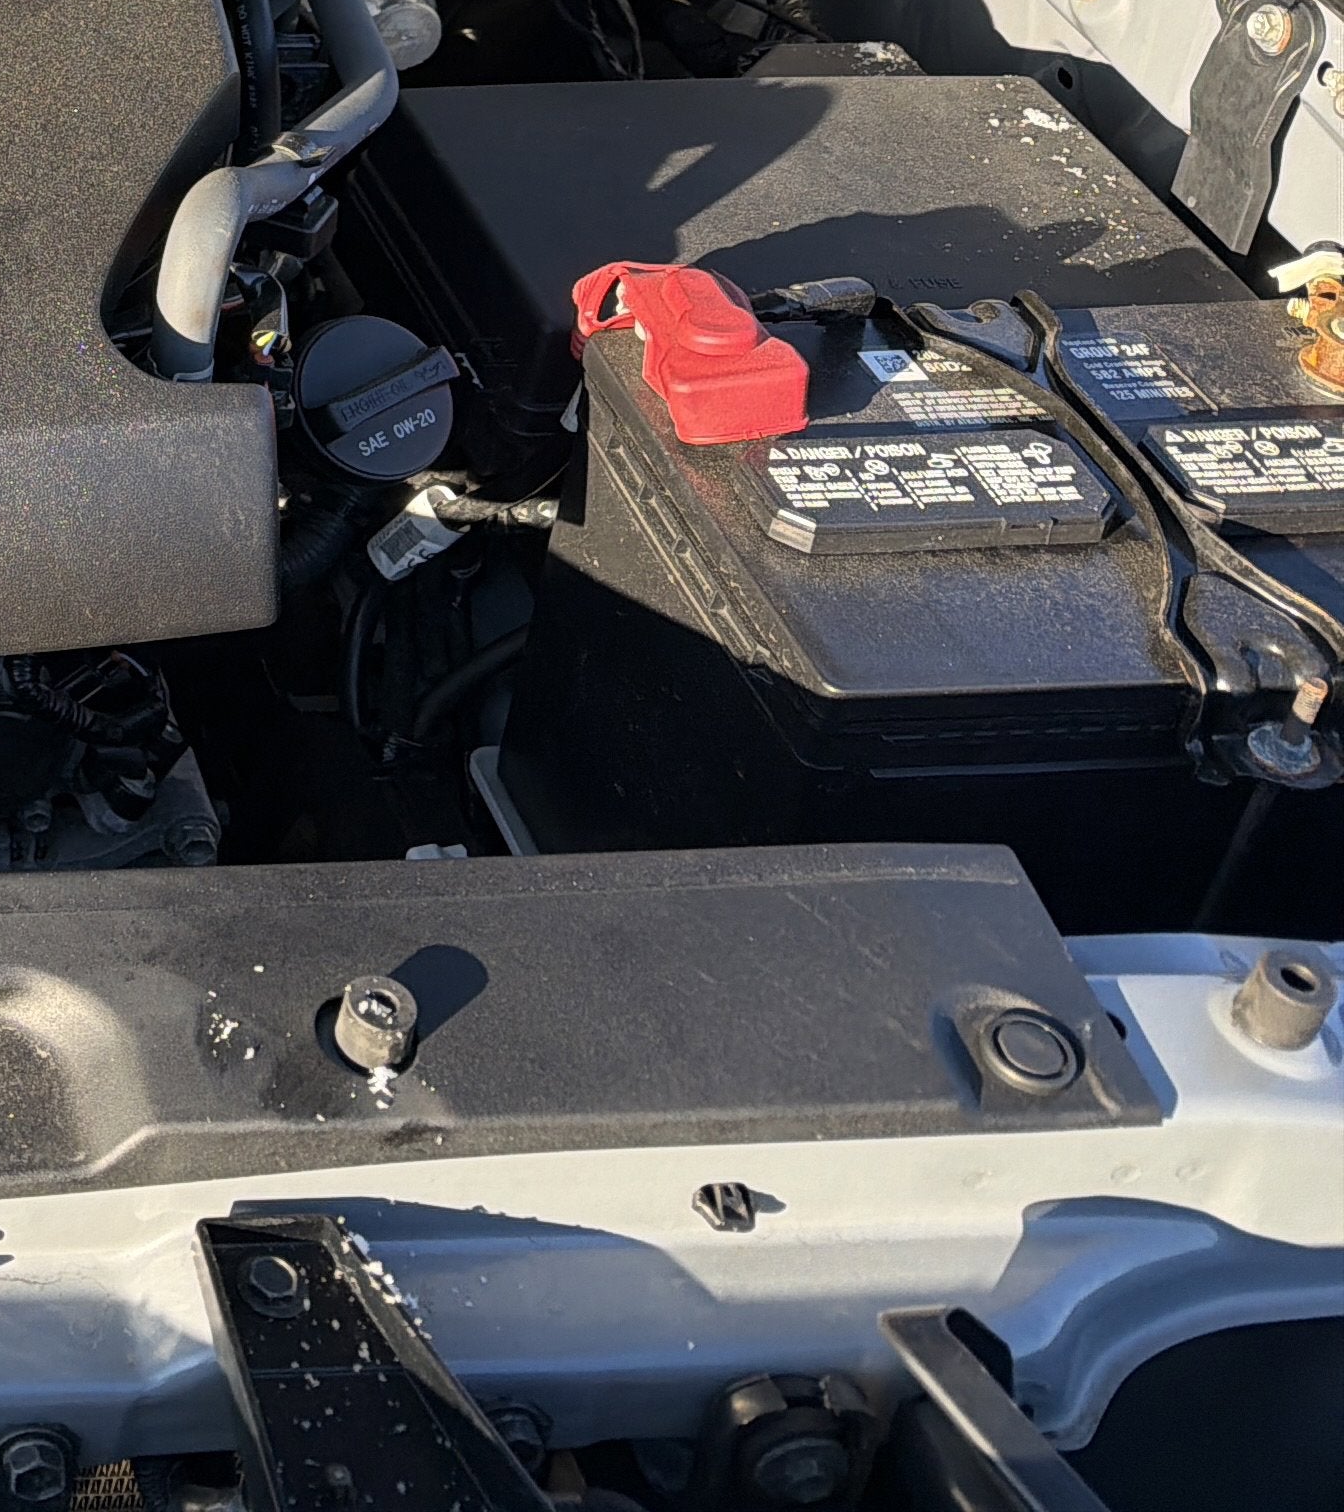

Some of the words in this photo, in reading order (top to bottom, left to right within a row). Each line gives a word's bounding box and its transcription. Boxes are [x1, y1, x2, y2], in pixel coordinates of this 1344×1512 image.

[909, 277, 964, 289] FUSE
[1069, 346, 1120, 359] GROUP
[1121, 343, 1152, 357] 24F
[1090, 369, 1122, 380] 582
[1123, 367, 1167, 379] AMPS
[1110, 389, 1135, 400] 125
[1136, 387, 1195, 399] MINUTES
[358, 431, 390, 457] SAE
[393, 408, 436, 439] 0W-20
[1181, 427, 1250, 443] DANGER
[1258, 424, 1323, 440] POISON
[786, 445, 853, 460] DANGER
[863, 443, 927, 458] POISON
